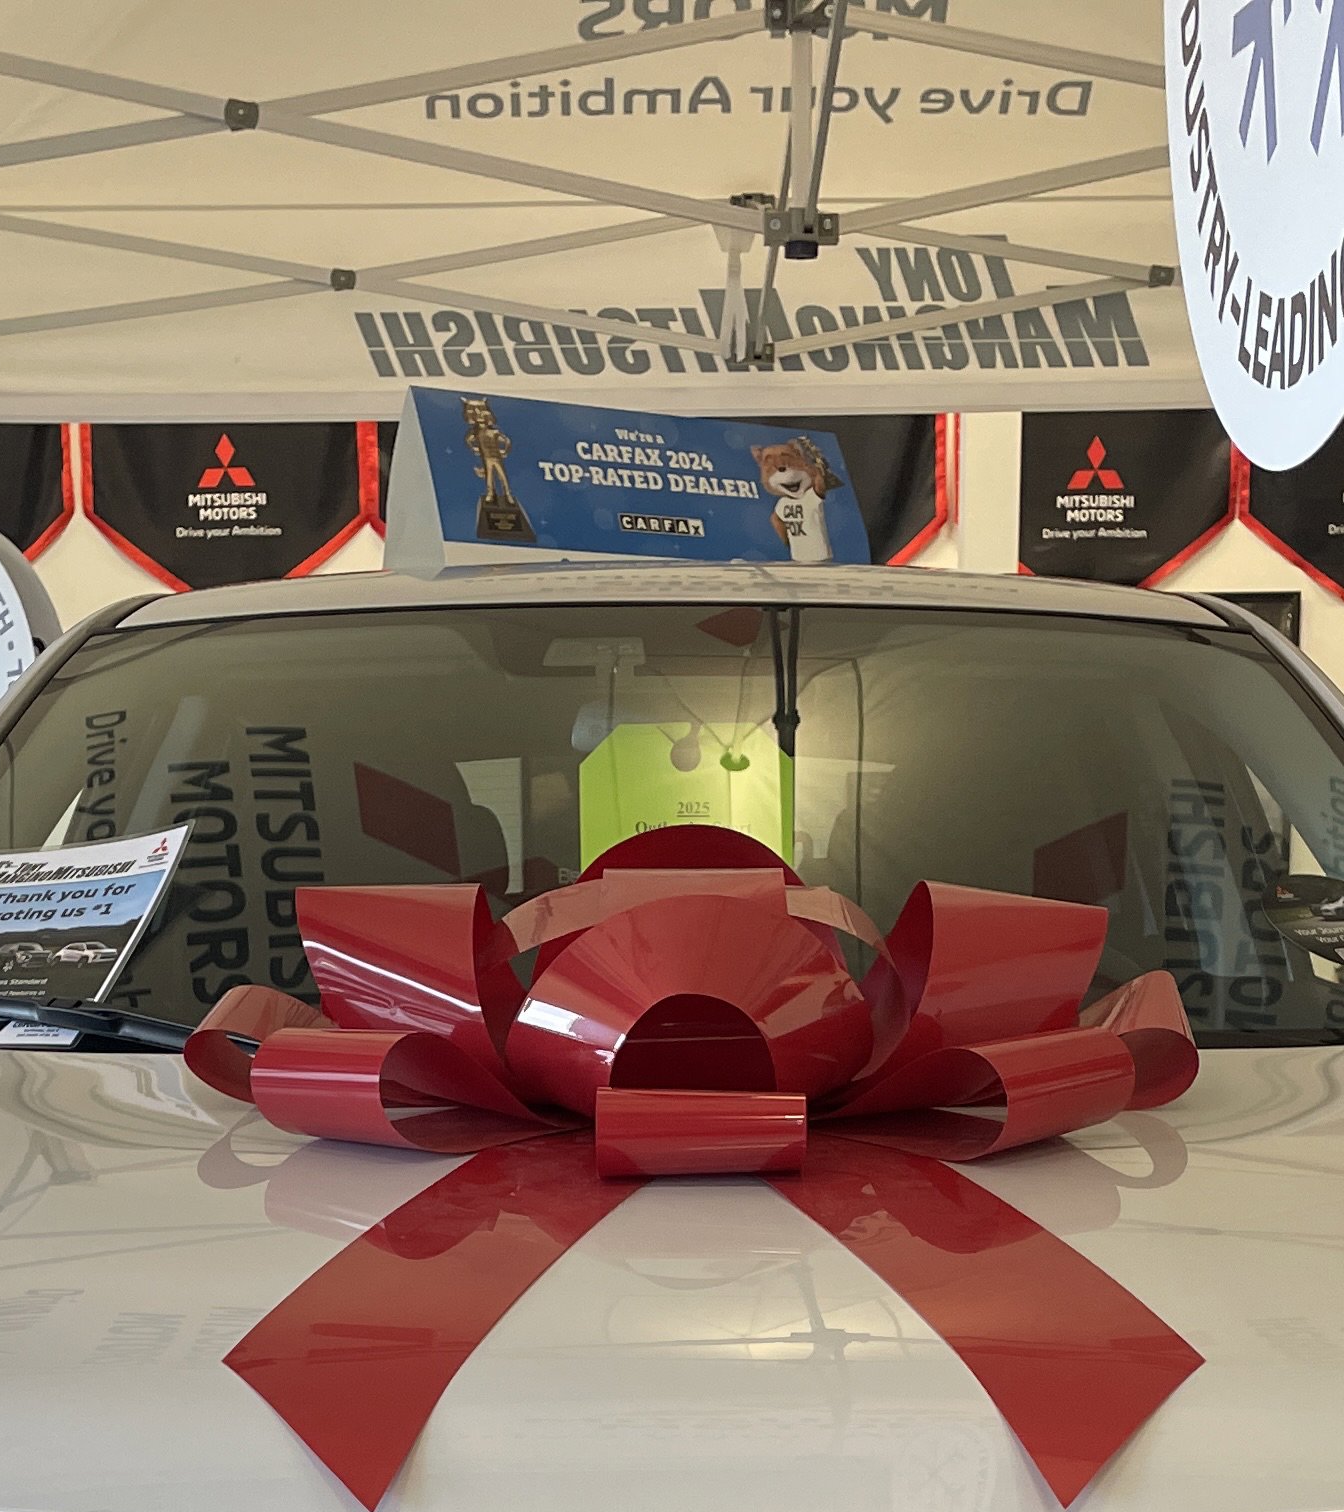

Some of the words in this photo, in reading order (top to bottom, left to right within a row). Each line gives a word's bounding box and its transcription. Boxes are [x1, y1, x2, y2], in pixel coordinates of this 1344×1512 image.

[654, 434, 665, 446] a
[575, 441, 662, 468] CARFAX
[666, 449, 714, 473] 2024
[538, 460, 664, 493] TOP-RATED
[667, 473, 759, 500] DEALER!
[187, 493, 267, 507] MITSUBISHI
[1056, 494, 1134, 509] MITSUBISHI
[199, 508, 257, 521] MOTORS
[783, 504, 804, 520] CAR
[1066, 509, 1124, 523] MOTORS
[176, 526, 204, 537] Drive
[206, 528, 230, 540] your
[232, 525, 282, 536] Ambition
[619, 513, 704, 537] CARFAX
[784, 520, 807, 537] FOX
[1042, 528, 1069, 538] Drive
[1070, 530, 1096, 541] your
[1097, 527, 1147, 538] Ambition
[677, 802, 710, 814] 2025
[57, 886, 96, 903] you
[103, 884, 136, 897] for
[60, 907, 86, 917] us
[92, 903, 113, 915] #1
